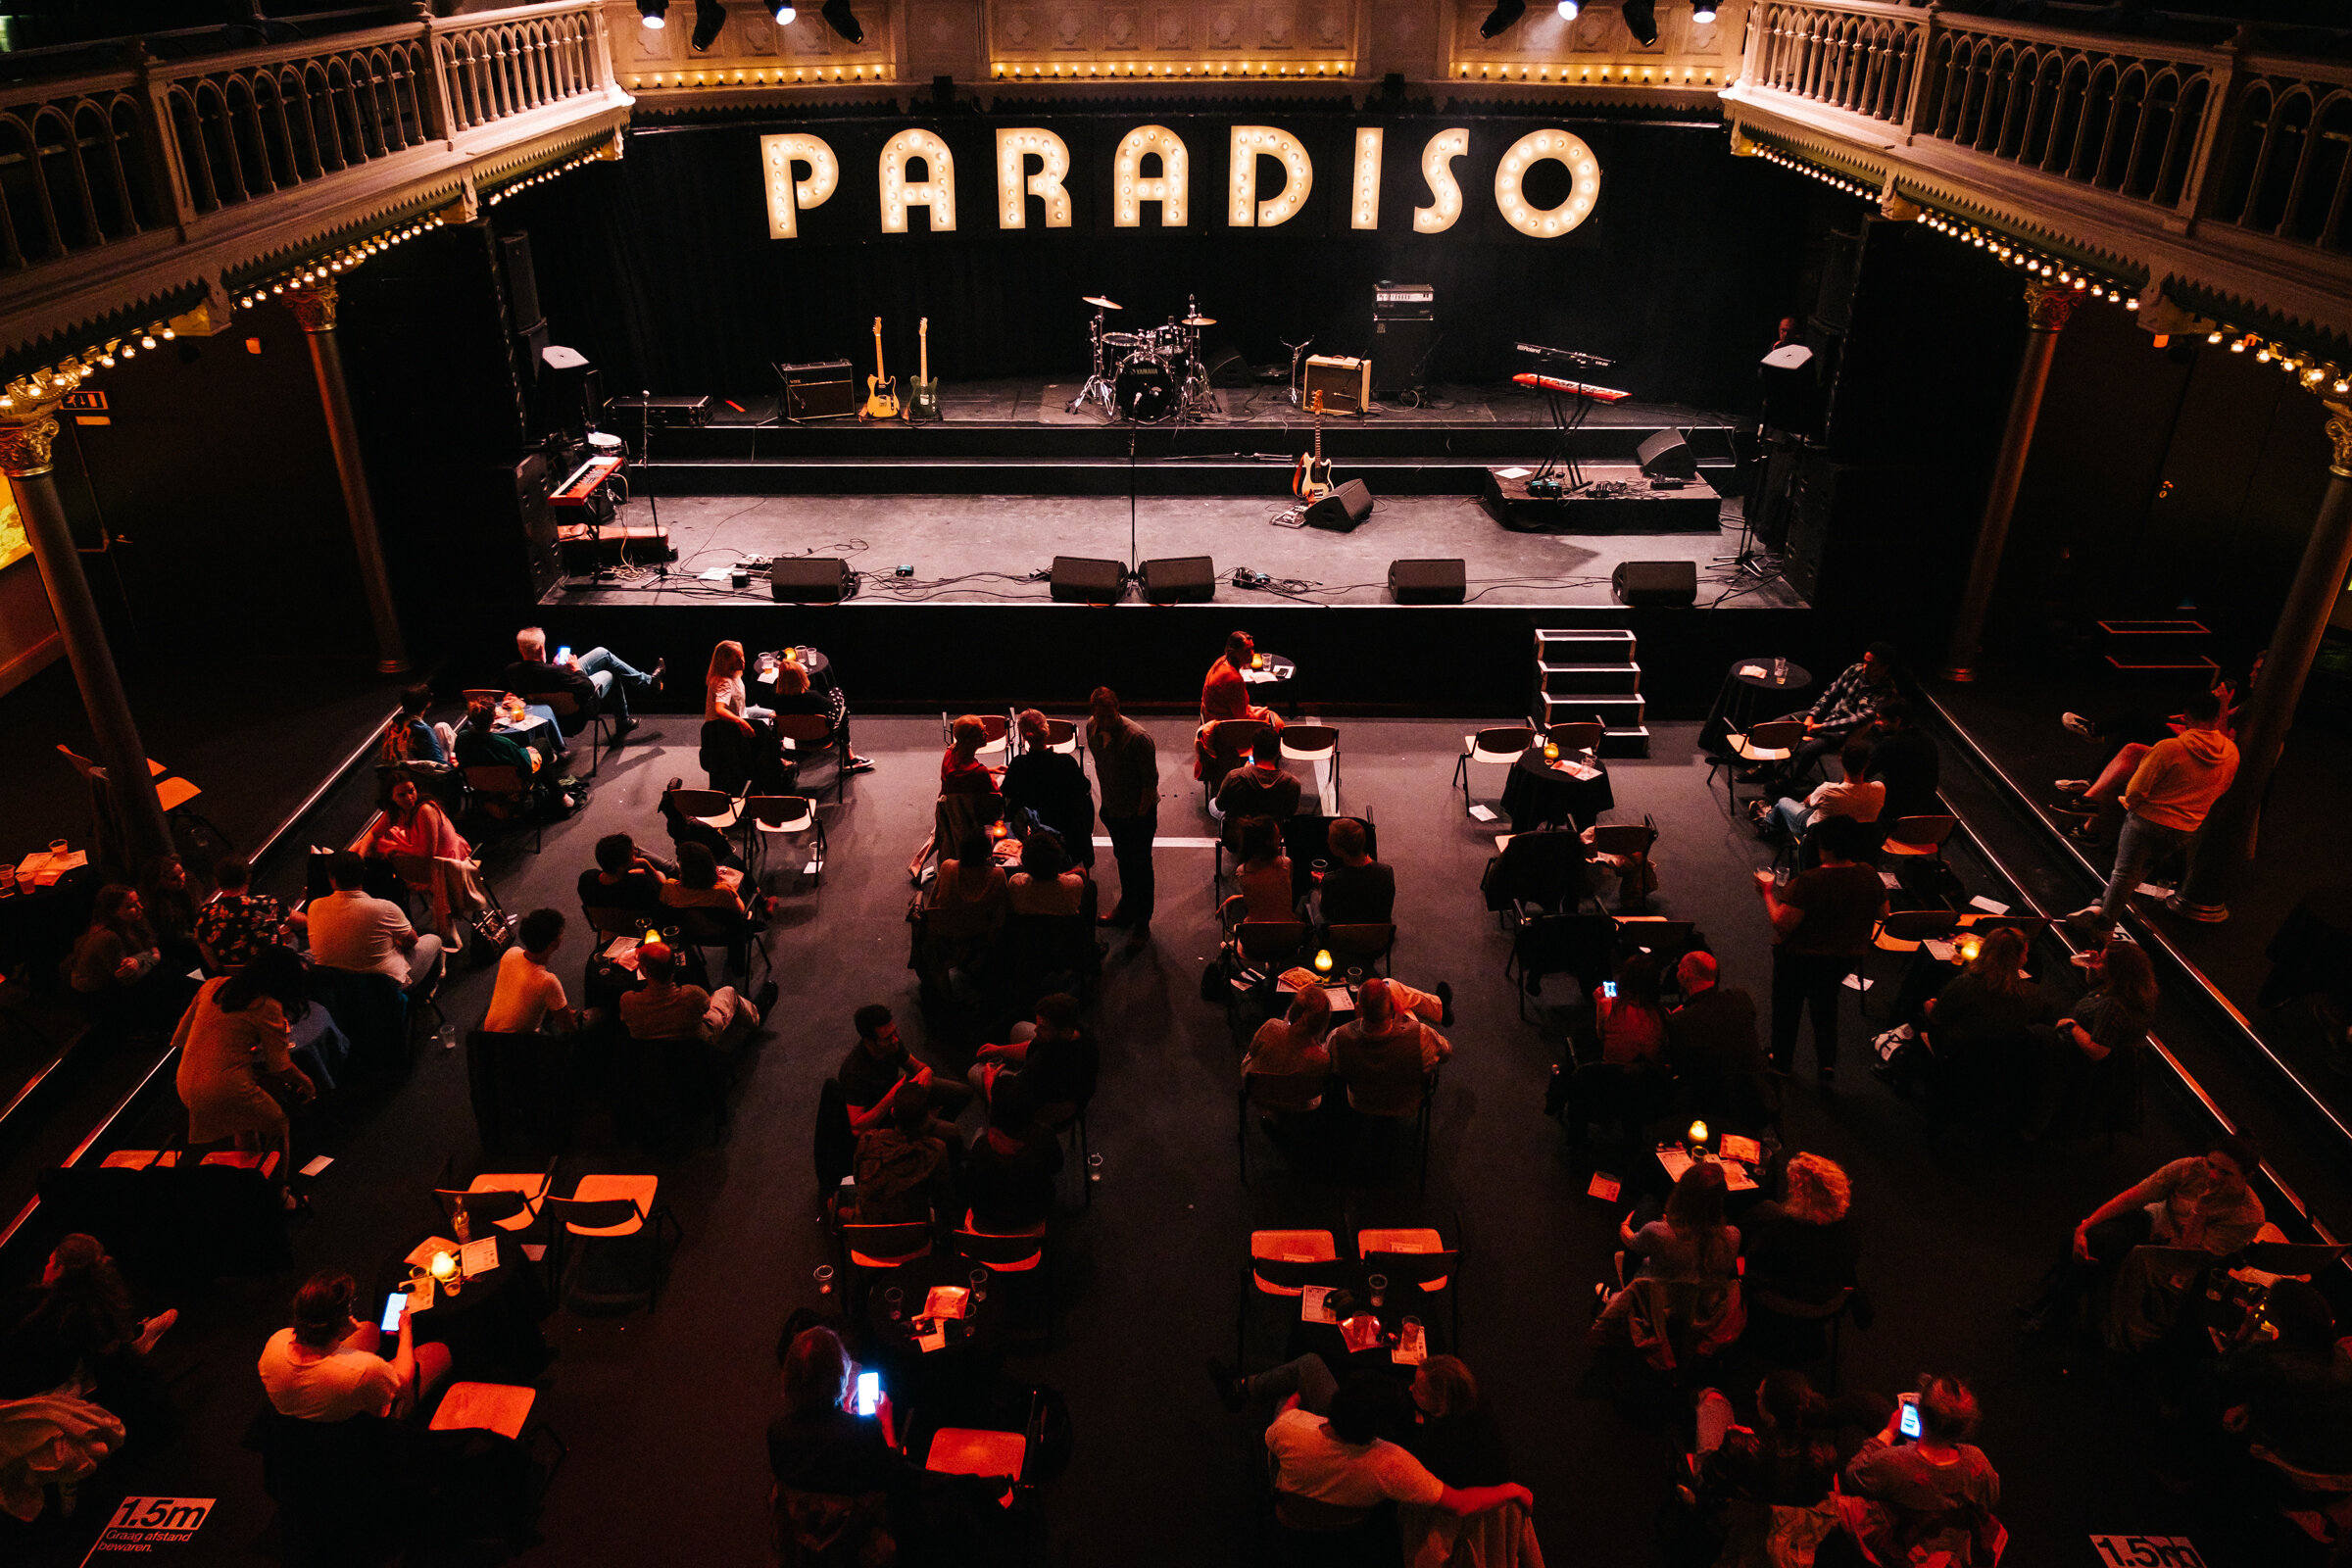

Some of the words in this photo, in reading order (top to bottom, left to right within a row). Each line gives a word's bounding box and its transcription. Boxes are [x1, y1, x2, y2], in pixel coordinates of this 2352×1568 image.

[760, 125, 1600, 239] PARADISO
[119, 1498, 206, 1528] 1.5m
[98, 1542, 152, 1552] bewaren.
[106, 1530, 142, 1543] Graag
[145, 1532, 193, 1543] afstand
[2097, 1537, 2205, 1568] 1.5m
